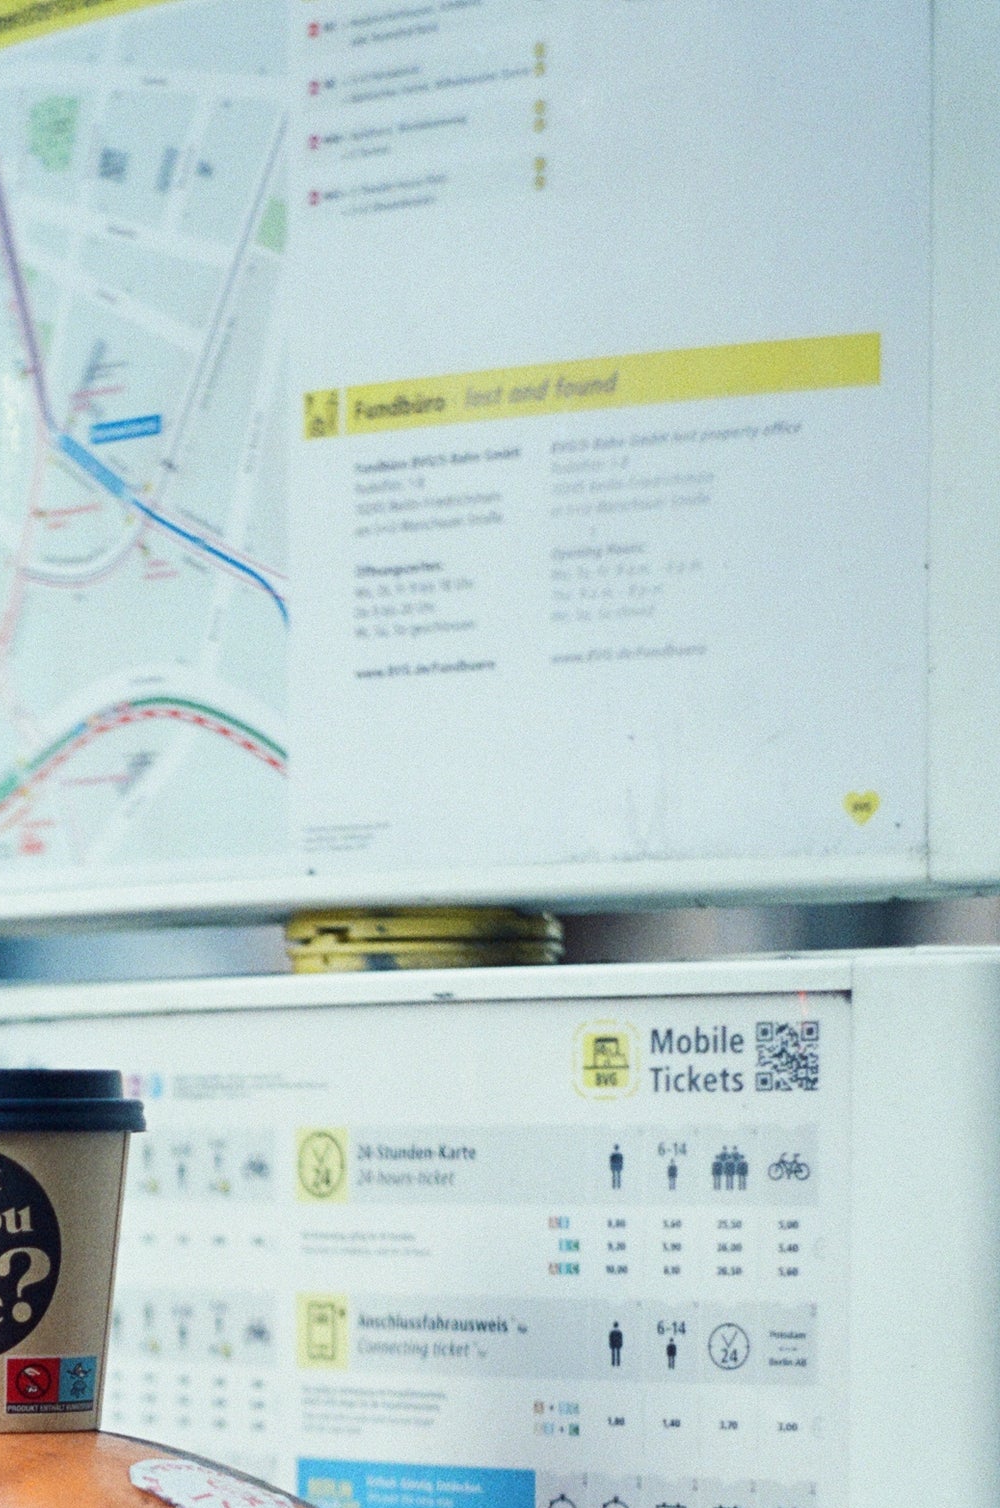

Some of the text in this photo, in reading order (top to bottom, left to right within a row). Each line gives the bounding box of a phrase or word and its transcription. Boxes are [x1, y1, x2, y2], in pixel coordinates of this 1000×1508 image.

[354, 395, 447, 422] Fundbüro
[508, 377, 549, 403] and
[555, 369, 619, 398] found
[595, 1025, 745, 1087] BVG Mobile
[649, 1065, 744, 1093] Tickets
[657, 1142, 688, 1157] 6-14
[358, 1312, 687, 1335] Anschlussfahrausweis 6-14
[432, 1340, 470, 1357] ticket
[720, 1348, 739, 1364] 24
[7, 1403, 38, 1413] PRODUKT
